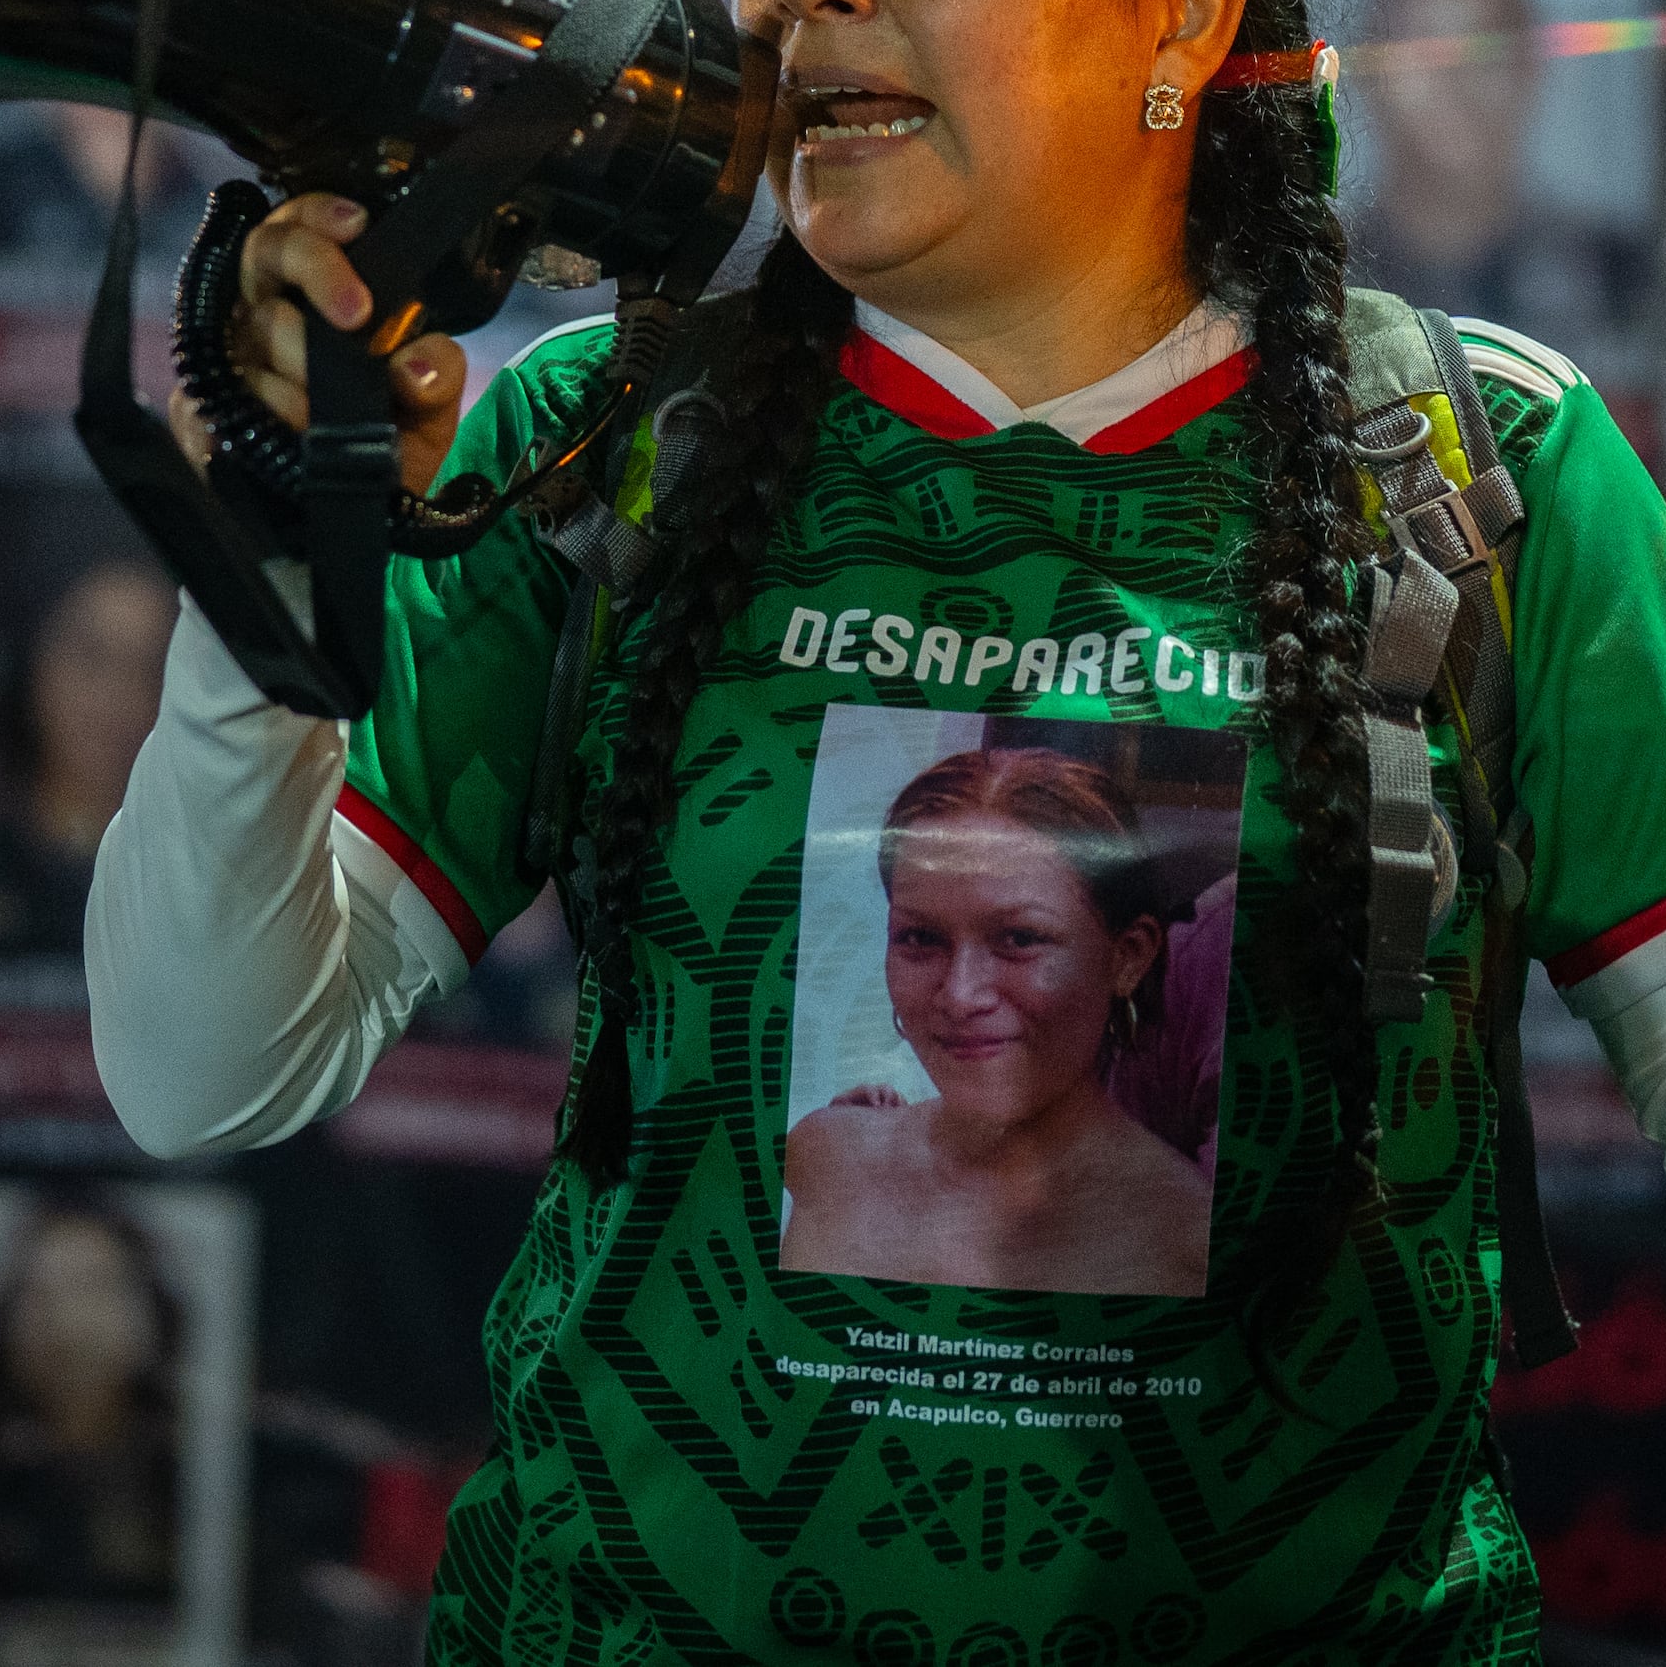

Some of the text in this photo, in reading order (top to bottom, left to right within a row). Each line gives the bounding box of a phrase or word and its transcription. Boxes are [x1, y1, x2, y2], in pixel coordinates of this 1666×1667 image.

[779, 606, 1268, 702] DESAPARECID
[845, 1326, 1135, 1363] Yatzil Martínez Corrales
[775, 1355, 1203, 1397] desaparecida el 27 de abril de 2010
[850, 1397, 1124, 1429] en Acapulco, Guerrero
